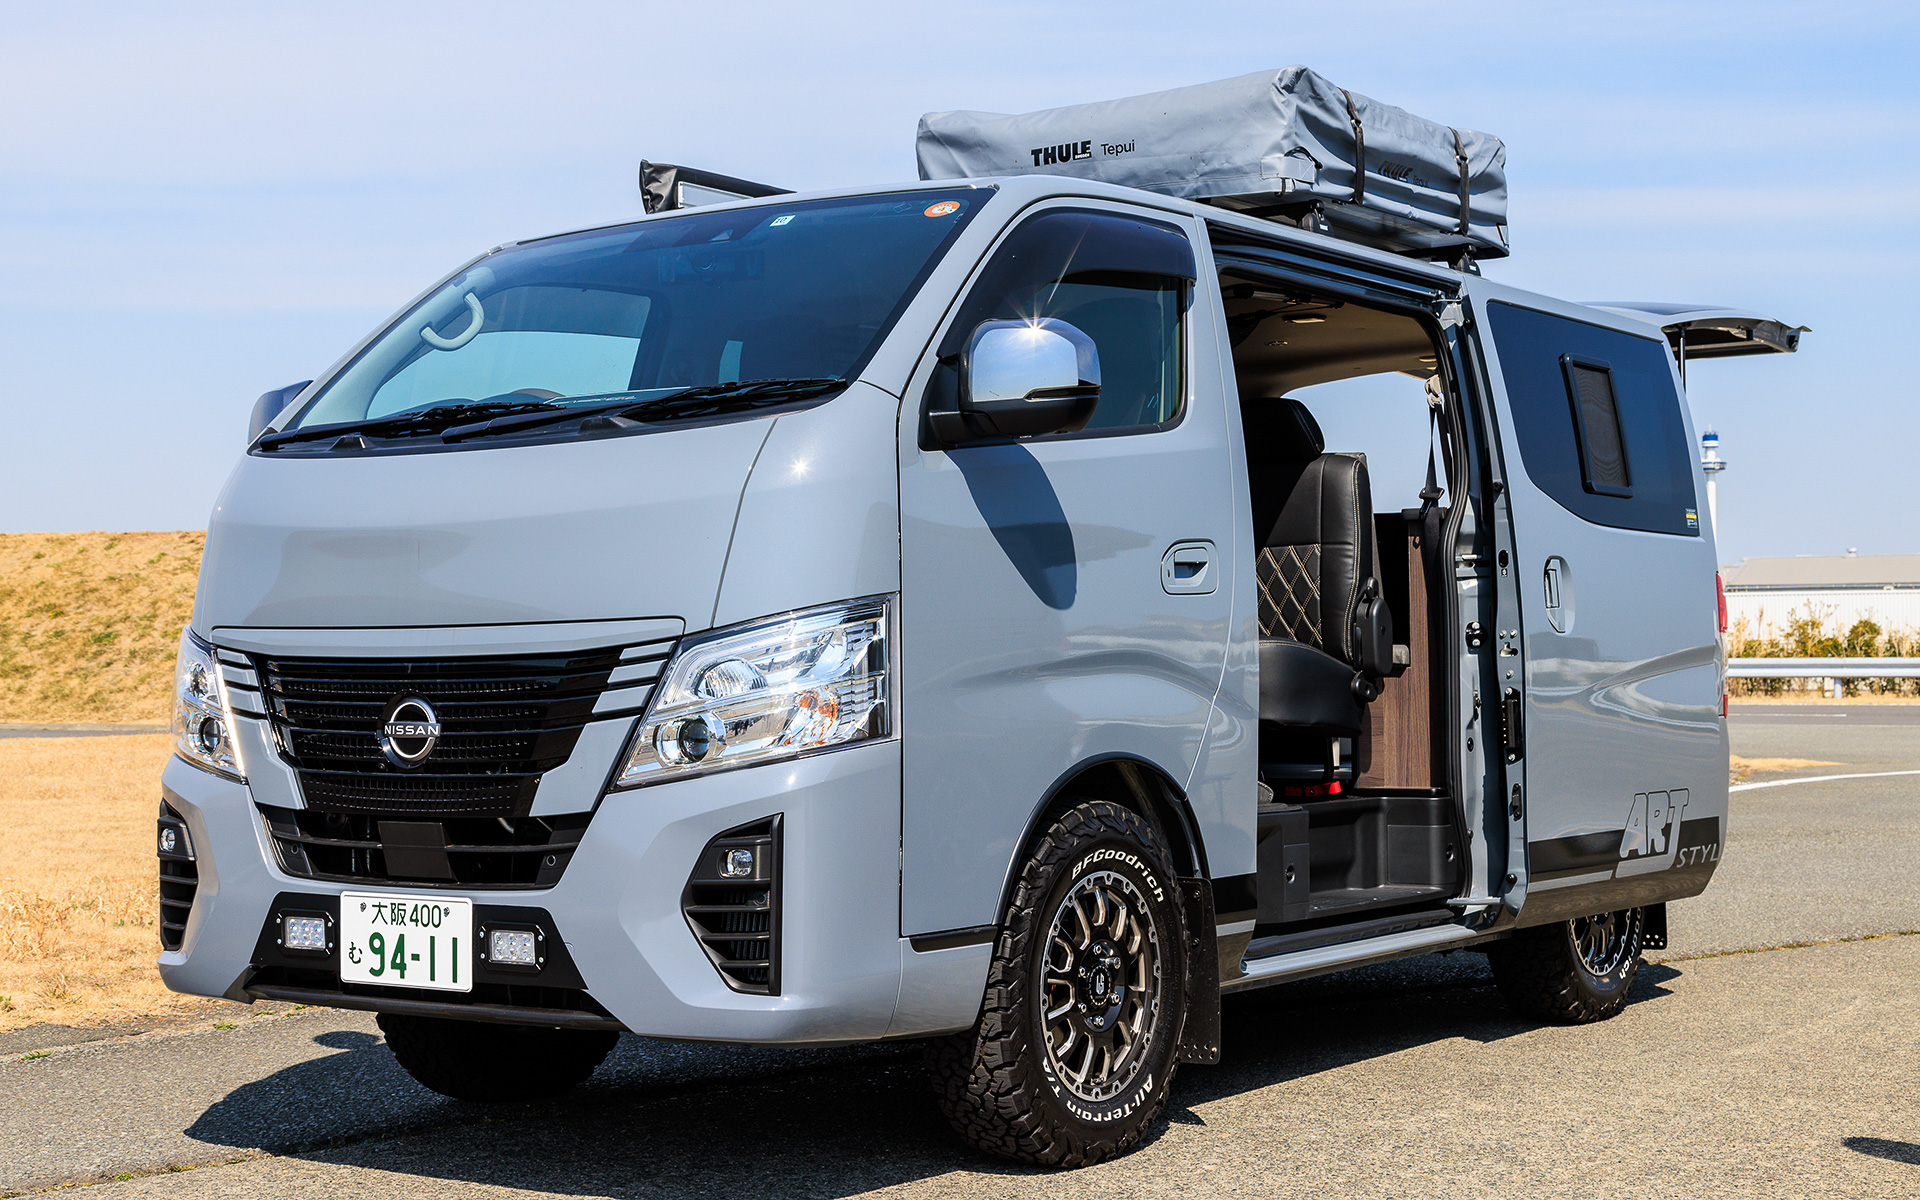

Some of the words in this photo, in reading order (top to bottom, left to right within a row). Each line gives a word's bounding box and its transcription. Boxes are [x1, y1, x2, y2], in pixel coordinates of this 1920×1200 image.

[1031, 140, 1092, 167] THULE
[1100, 139, 1135, 156] Tepui
[384, 725, 439, 735] NISSAN
[1619, 788, 1690, 862] ART
[1676, 843, 1720, 868] STYL
[1072, 849, 1164, 902] BFGoodrich
[349, 942, 363, 964] む
[369, 932, 458, 984] 94-11
[1619, 907, 1642, 979] oodrich
[1042, 1057, 1060, 1098] T/A
[1066, 1073, 1153, 1121] All-Terrain
